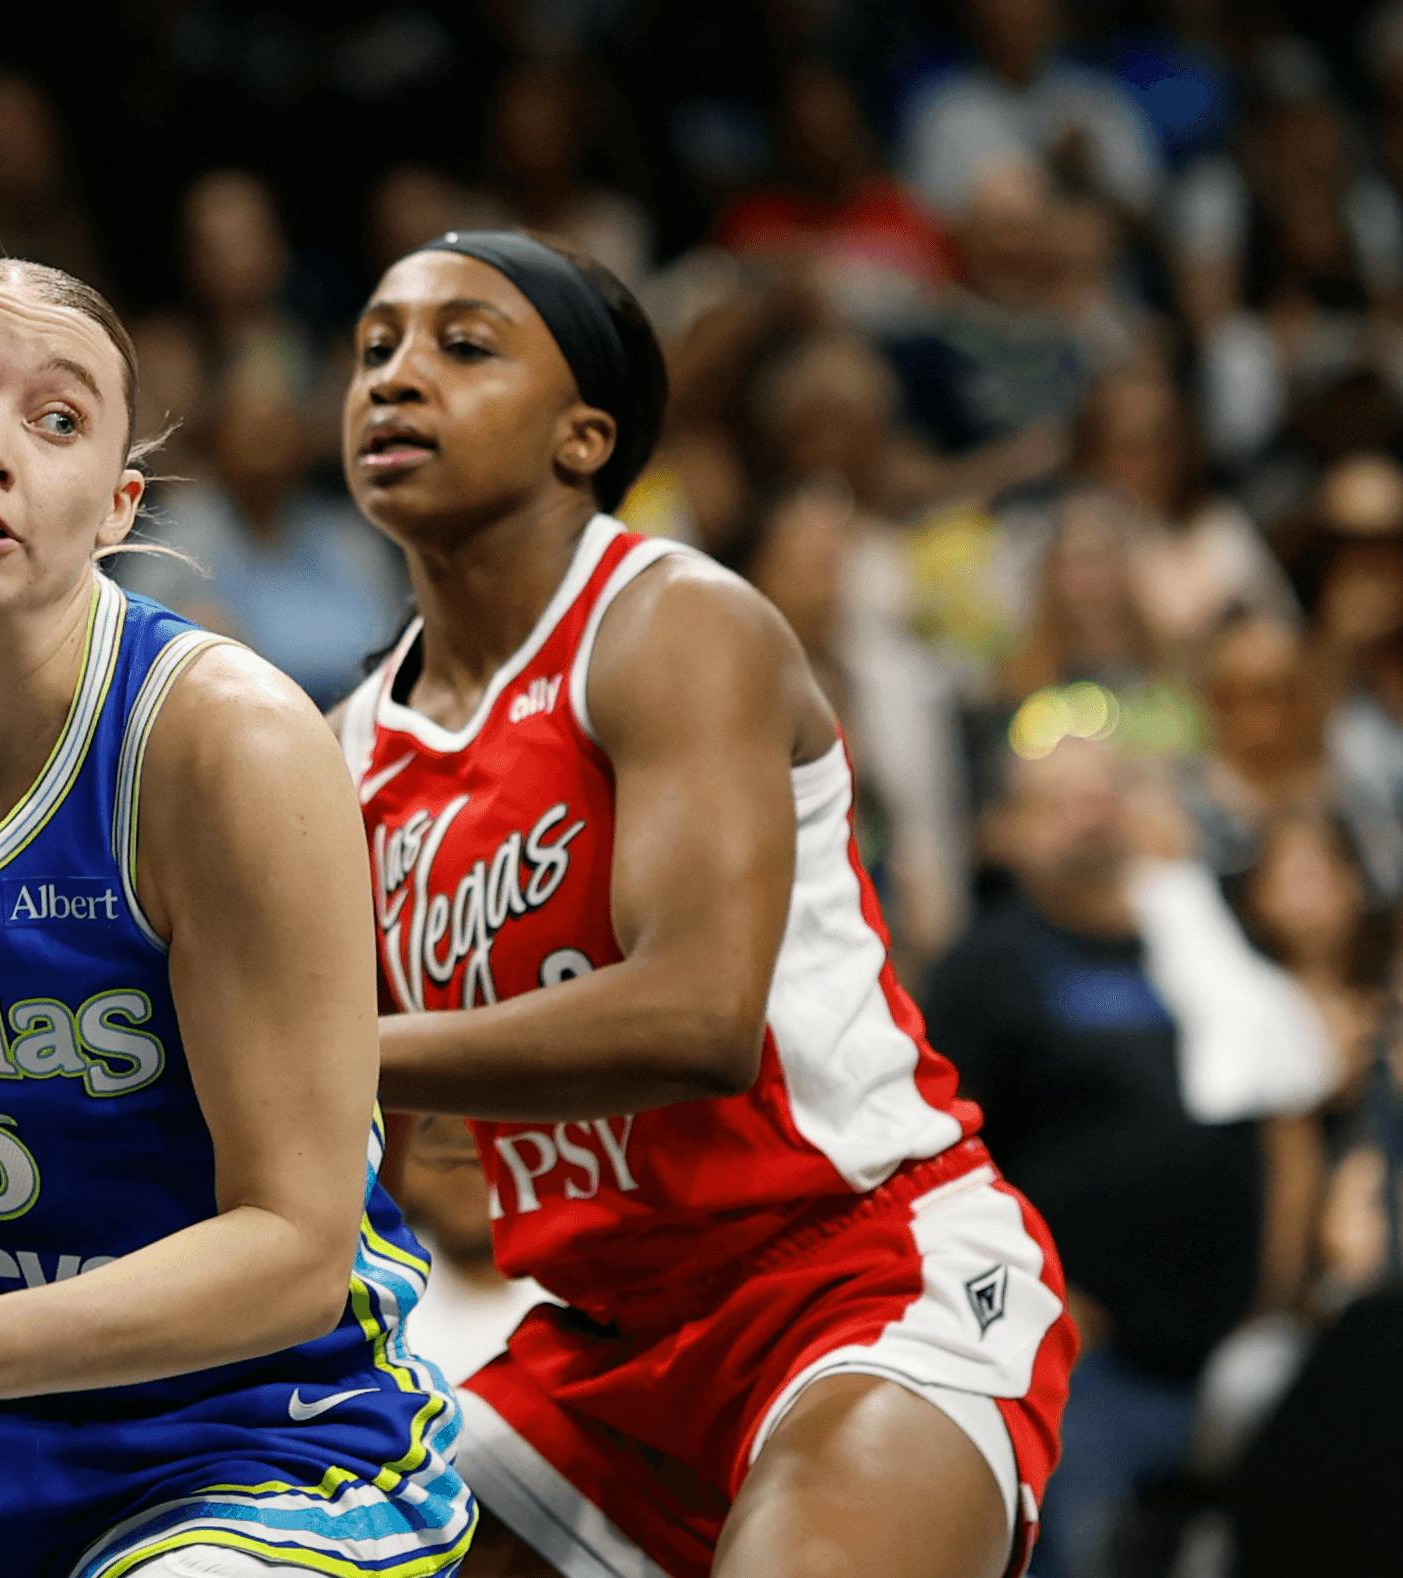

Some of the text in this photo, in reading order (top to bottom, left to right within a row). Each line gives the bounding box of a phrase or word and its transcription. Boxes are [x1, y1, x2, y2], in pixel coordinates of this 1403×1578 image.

[508, 672, 564, 724] ally
[10, 884, 119, 921] Albert
[385, 794, 587, 1014] Vegas
